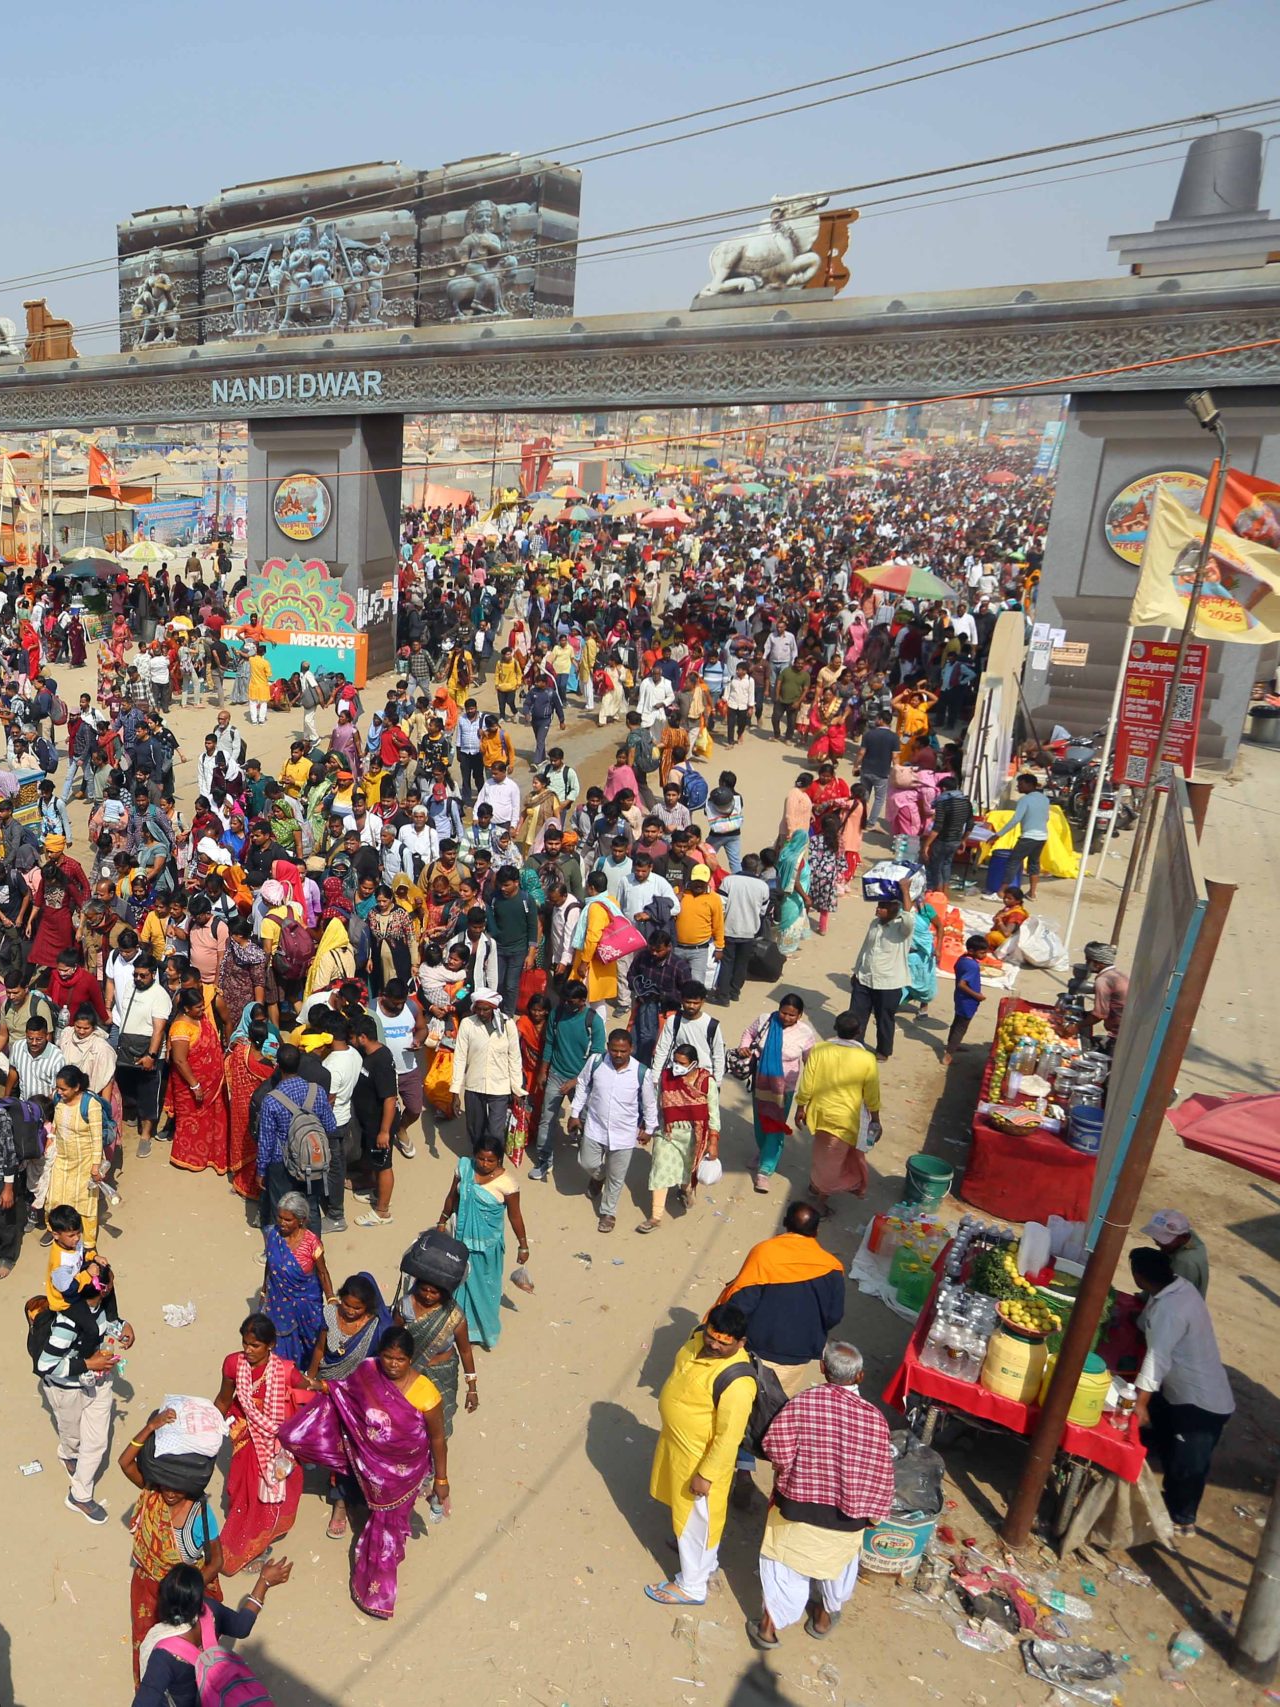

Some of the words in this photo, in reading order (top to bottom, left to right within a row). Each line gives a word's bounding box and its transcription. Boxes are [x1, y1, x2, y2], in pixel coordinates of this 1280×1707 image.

[212, 374, 292, 403] NANDI
[298, 370, 383, 398] DWAR
[1208, 609, 1242, 622] 2025
